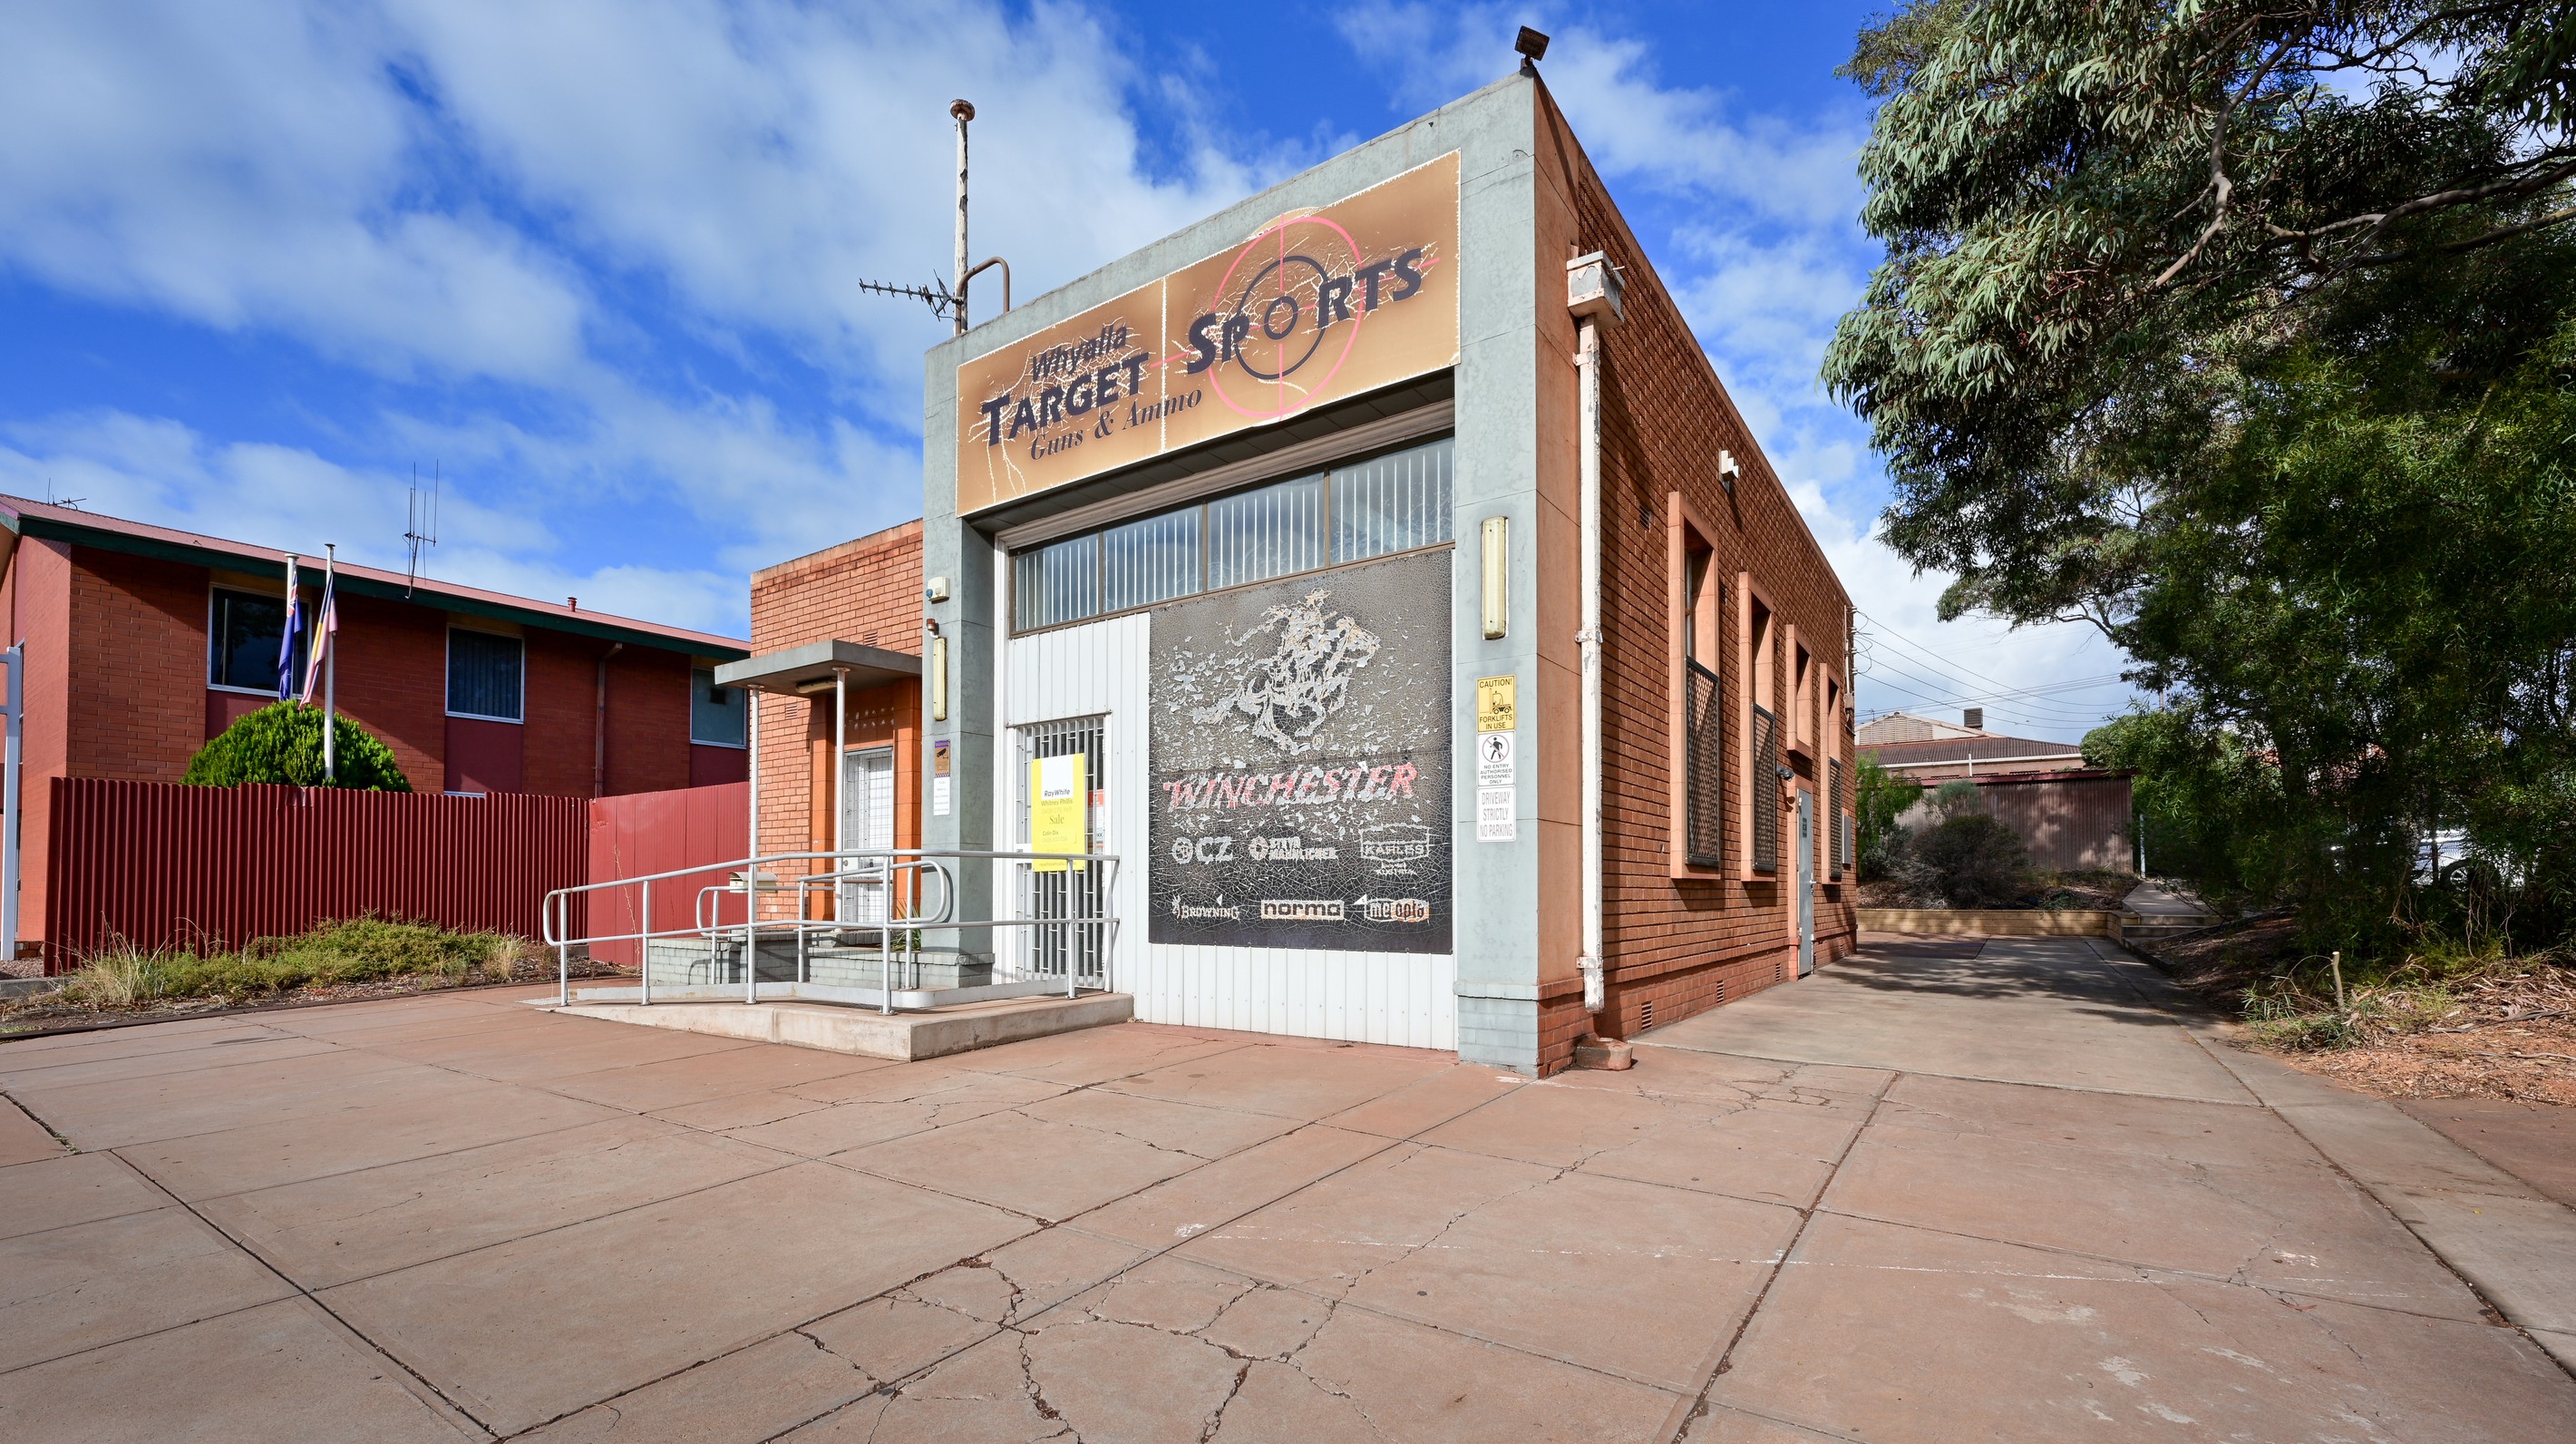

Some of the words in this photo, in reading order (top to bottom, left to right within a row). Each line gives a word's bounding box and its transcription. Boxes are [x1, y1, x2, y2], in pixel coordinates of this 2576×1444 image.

[982, 352, 1150, 447] TARGET
[1186, 248, 1423, 376] SPORTS
[1033, 322, 1127, 382] Whyalla
[1030, 428, 1084, 461] Guns
[1094, 410, 1114, 440] &
[1123, 388, 1202, 431] Ammo
[1479, 678, 1512, 688] CAUTION!
[1479, 714, 1513, 723] FORKLIFTS
[1162, 762, 1418, 812] WINCHESTER
[1482, 791, 1511, 805] DRIVEWAY
[1049, 814, 1065, 824] Sale
[1483, 807, 1509, 821] STRICTLY
[1480, 824, 1488, 837] NO
[1489, 824, 1513, 837] PARKING
[1195, 836, 1234, 863] CZ
[1181, 904, 1240, 920] BROWNING
[1263, 902, 1343, 918] norma
